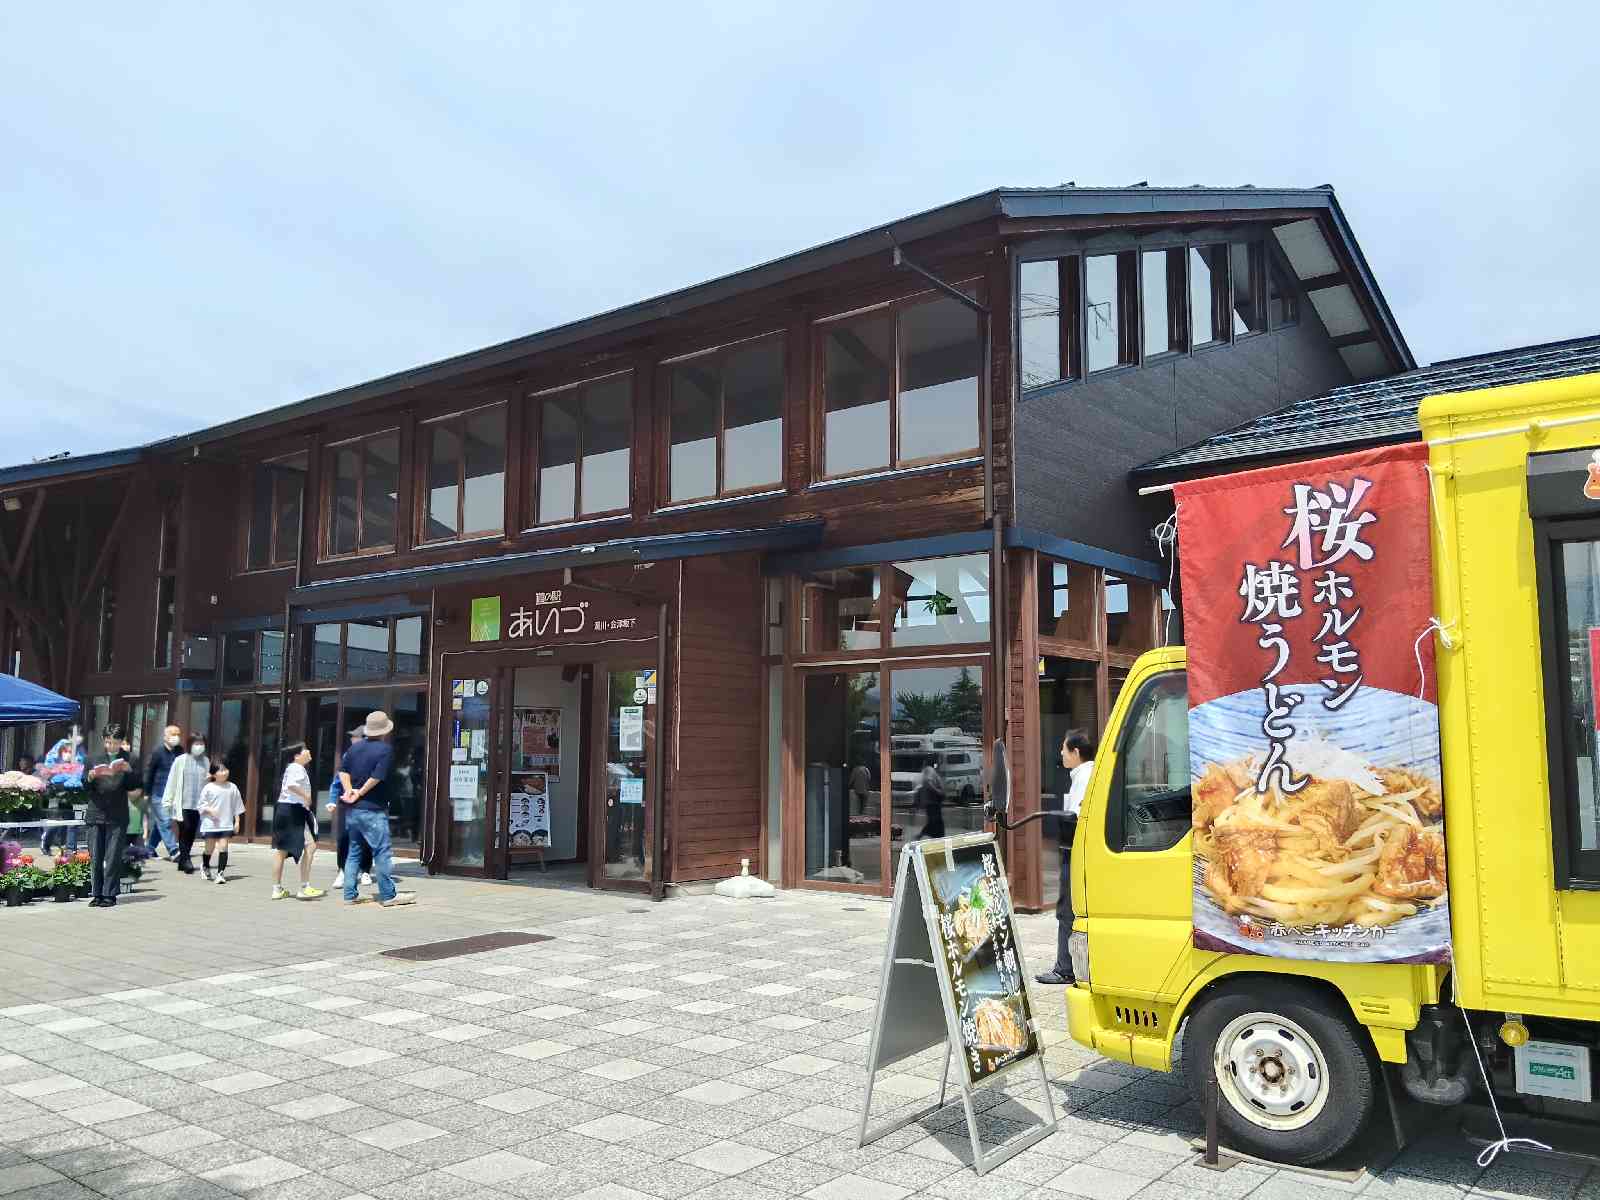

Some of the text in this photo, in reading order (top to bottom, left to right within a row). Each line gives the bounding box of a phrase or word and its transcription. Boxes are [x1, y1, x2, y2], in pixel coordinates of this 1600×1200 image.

[535, 590, 561, 605] 道の駅
[508, 601, 590, 638] あいづ
[1240, 562, 1309, 794] 焼うどん
